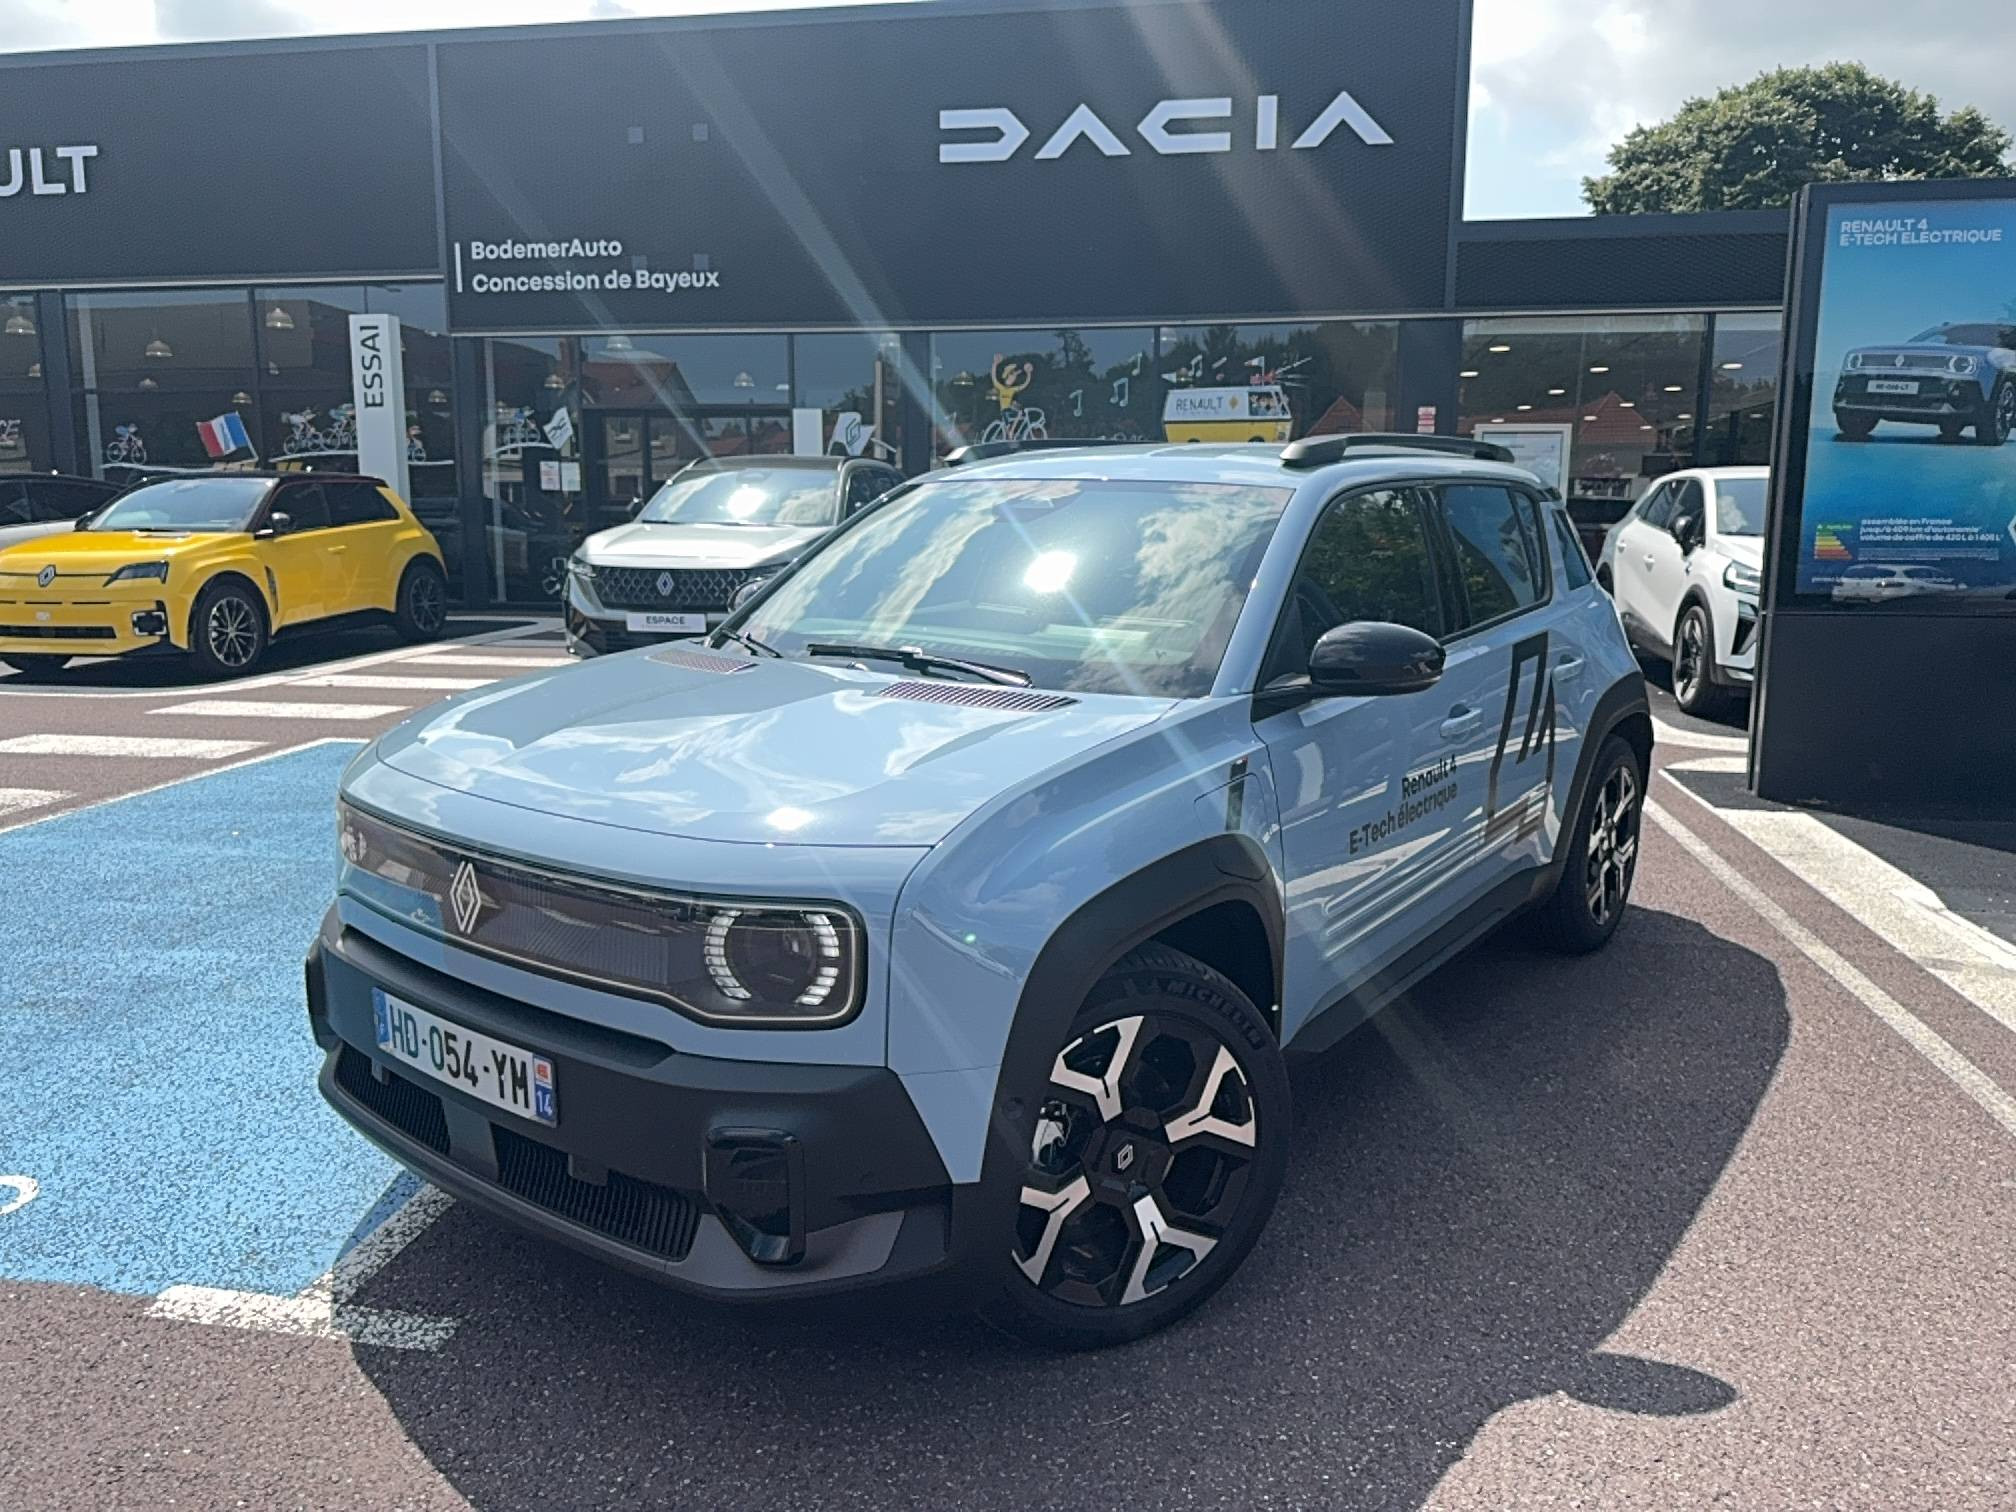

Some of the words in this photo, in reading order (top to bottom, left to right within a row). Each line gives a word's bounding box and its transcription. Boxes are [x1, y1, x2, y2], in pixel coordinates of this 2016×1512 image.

[939, 90, 1395, 163] DACIA
[1840, 218, 1916, 234] RENAULT
[1917, 217, 1929, 231] 4
[471, 238, 623, 260] BodemerAuto
[1839, 232, 1898, 247] E-TECH
[472, 271, 600, 293] Concession
[603, 269, 632, 289] de
[635, 270, 720, 293] Bayeux
[360, 325, 385, 409] ESSAI
[1175, 396, 1225, 413] RENAULT
[646, 615, 686, 625] ESPACE
[1402, 757, 1449, 800] Renault
[1449, 753, 1457, 774] 4
[1349, 811, 1396, 856] E-Tech
[1397, 782, 1458, 830] électrique
[390, 1003, 531, 1110] HD-054-YM
[537, 1089, 553, 1116] 14
